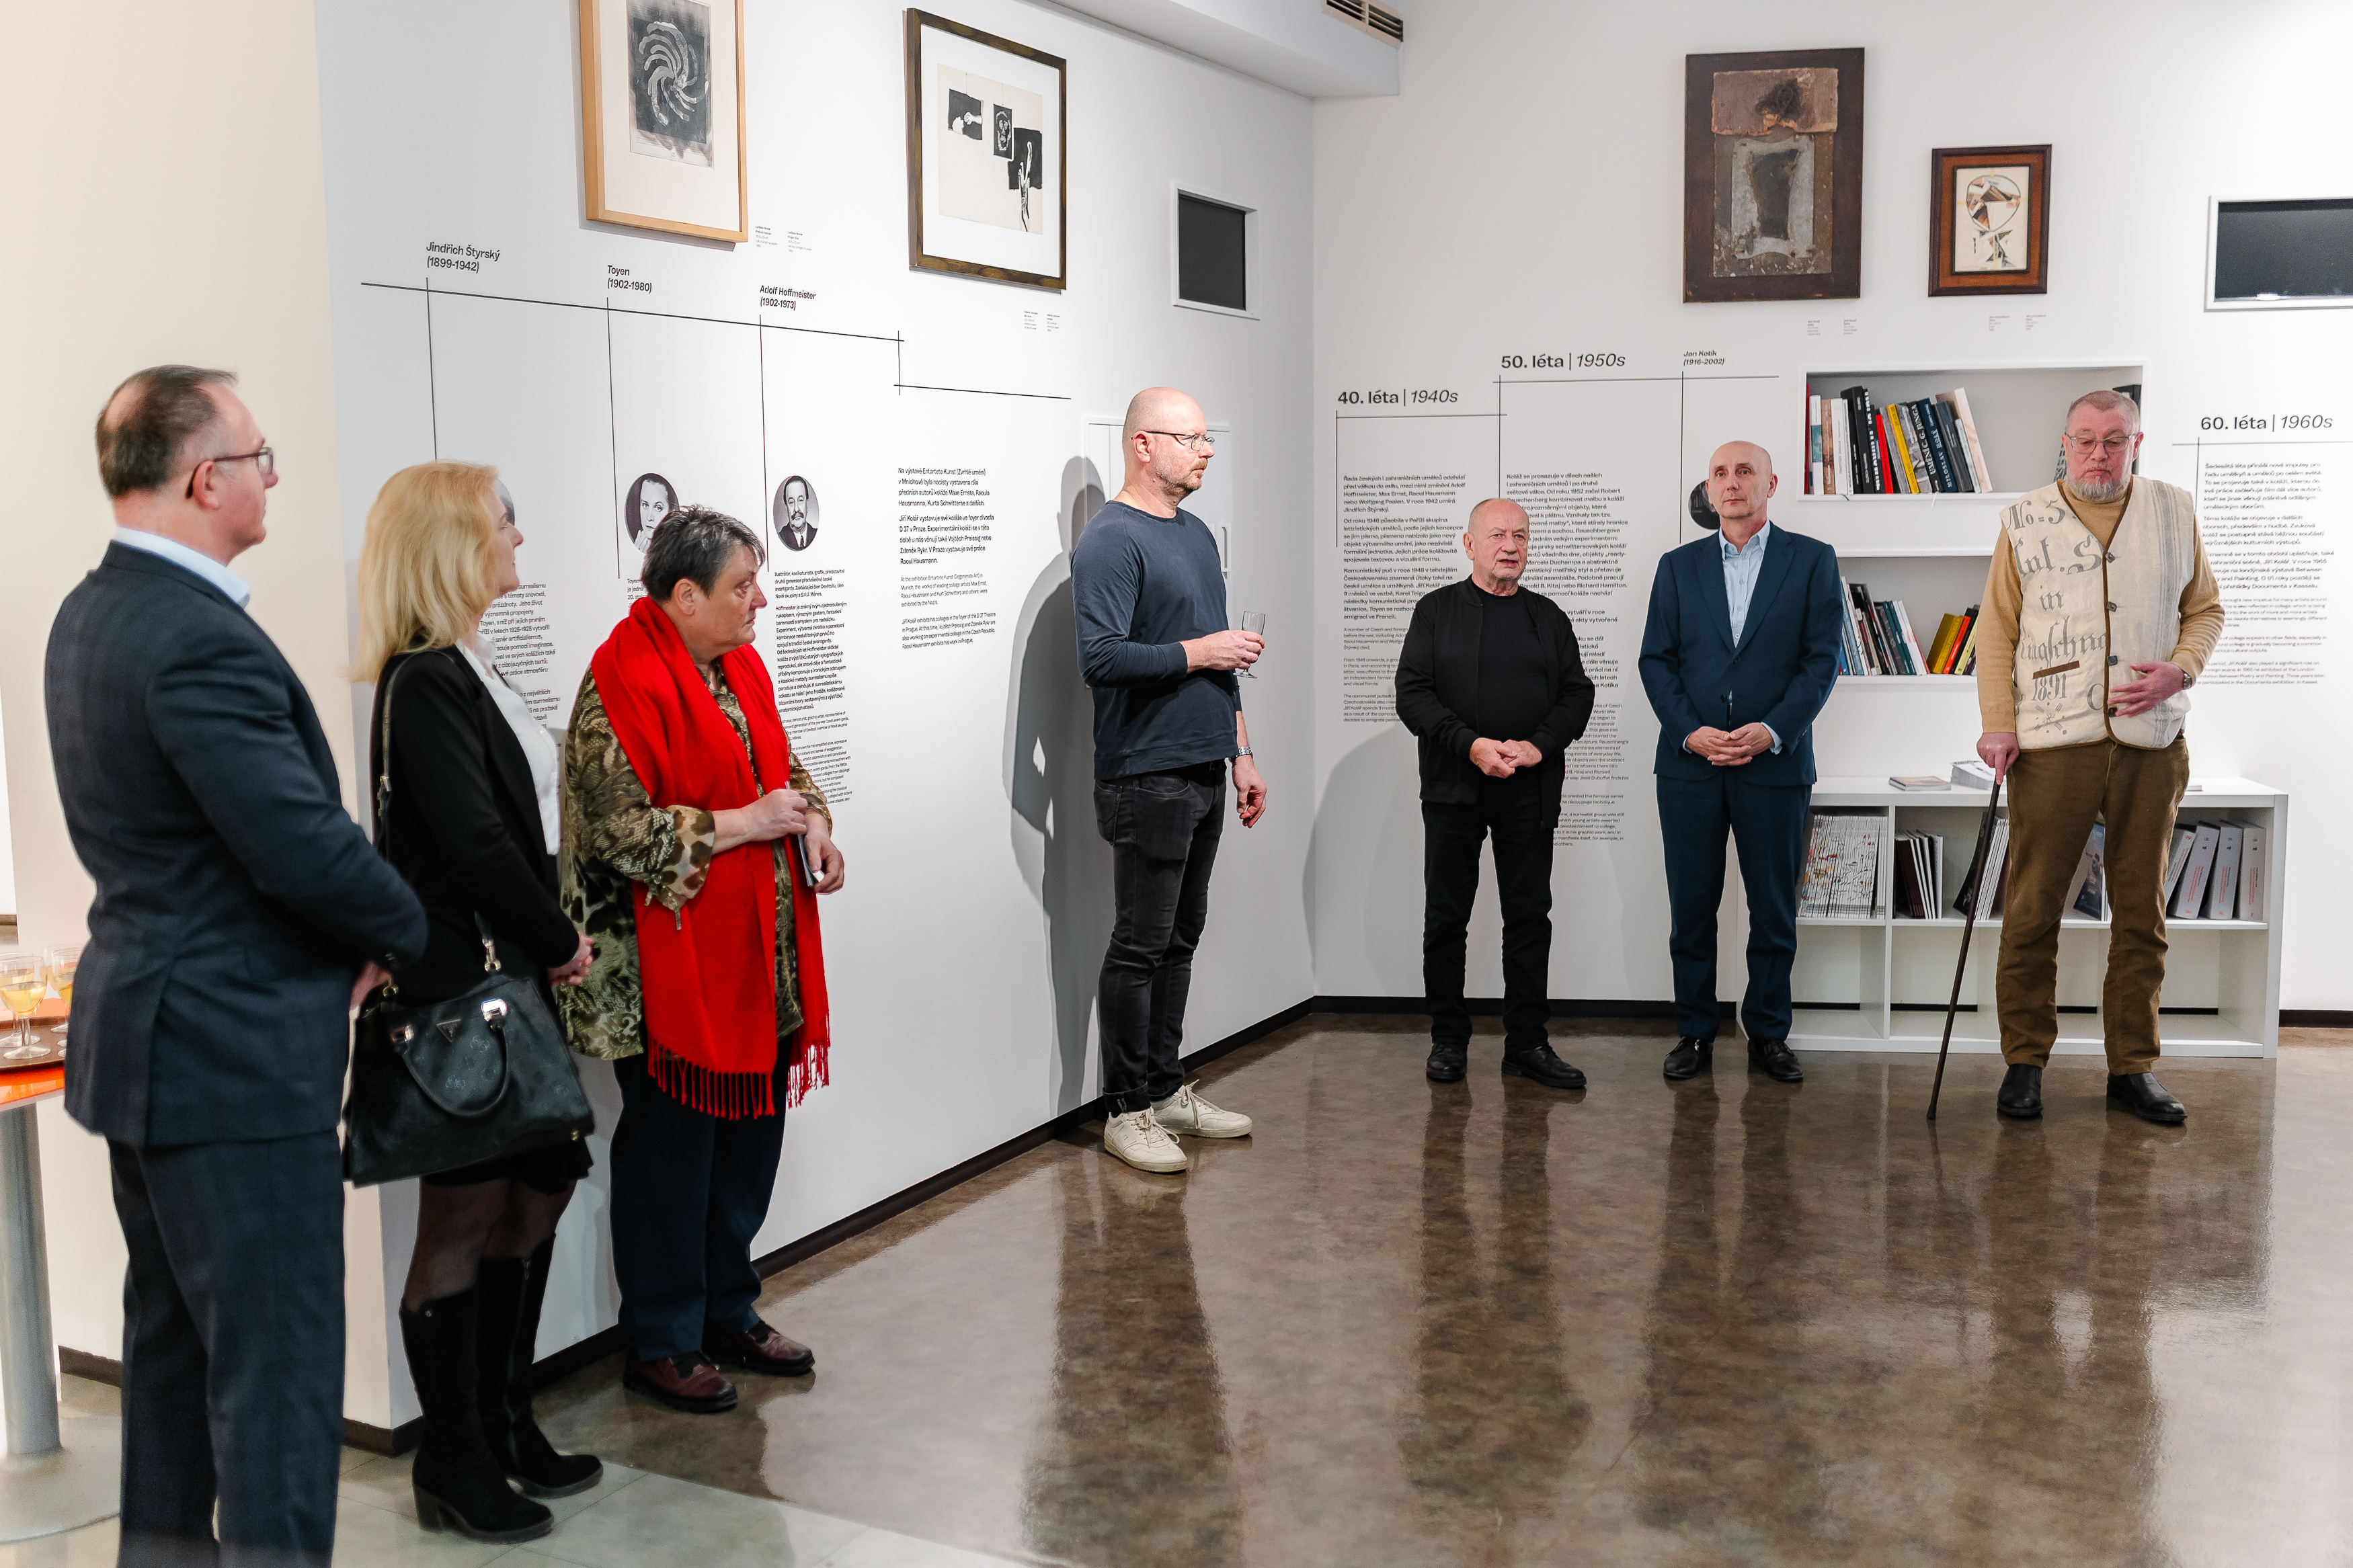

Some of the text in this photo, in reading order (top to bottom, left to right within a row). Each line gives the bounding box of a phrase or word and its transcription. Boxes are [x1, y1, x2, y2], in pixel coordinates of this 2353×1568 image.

[426, 242, 500, 261] Jindřich Štyrský
[427, 256, 479, 274] (1899-1942)
[607, 265, 629, 276] Toyen
[608, 278, 651, 294] (1902-1980)
[760, 285, 816, 299] Adolf Hoffmeister
[760, 296, 796, 311] (1902-1973)
[1501, 353, 1626, 368] 50. léta 1950s
[1683, 358, 1724, 366] (1916-2002)
[1338, 389, 1458, 404] 40. léta 1940s
[2201, 415, 2333, 429] 60. léta 1960s
[484, 610, 509, 618] významně
